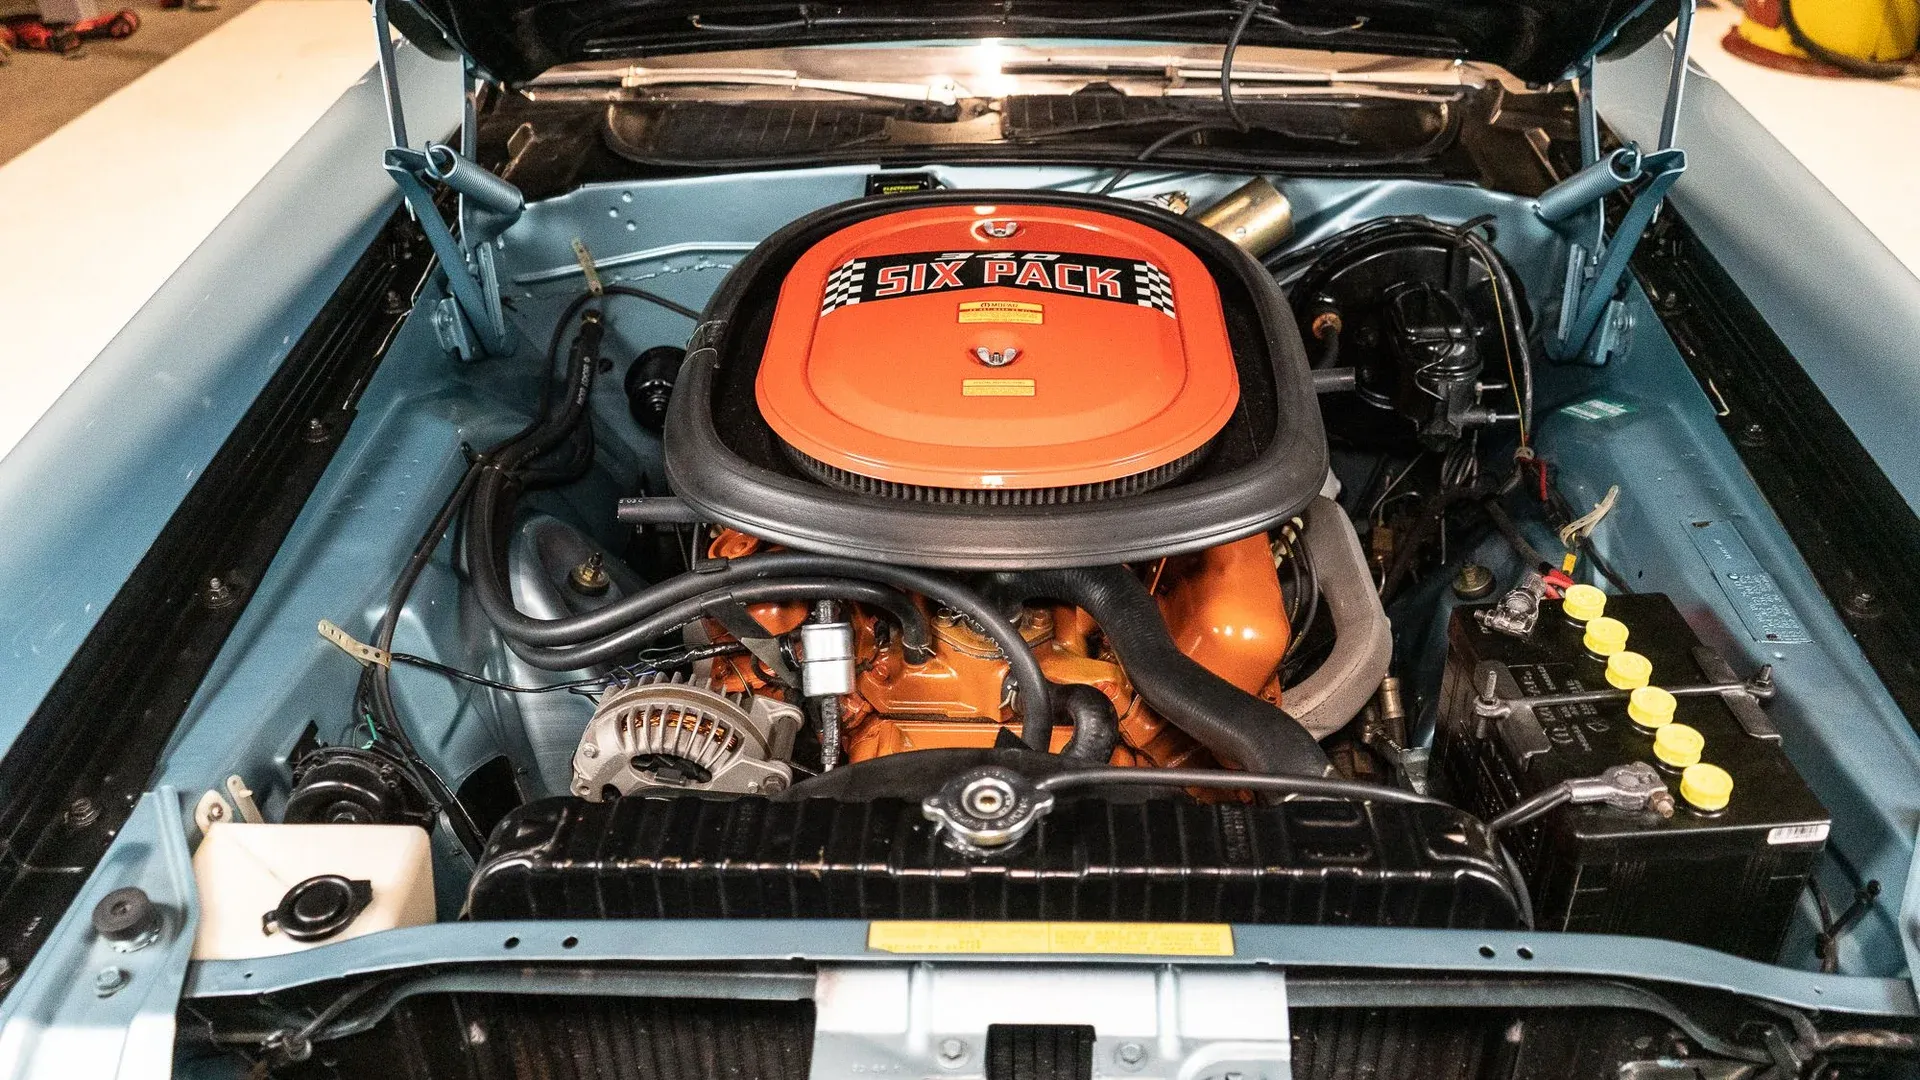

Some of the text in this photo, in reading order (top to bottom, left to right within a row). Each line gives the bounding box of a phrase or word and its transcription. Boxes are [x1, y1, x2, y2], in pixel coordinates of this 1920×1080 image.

[935, 252, 1061, 261] 340
[875, 260, 1122, 299] SIX PACK
